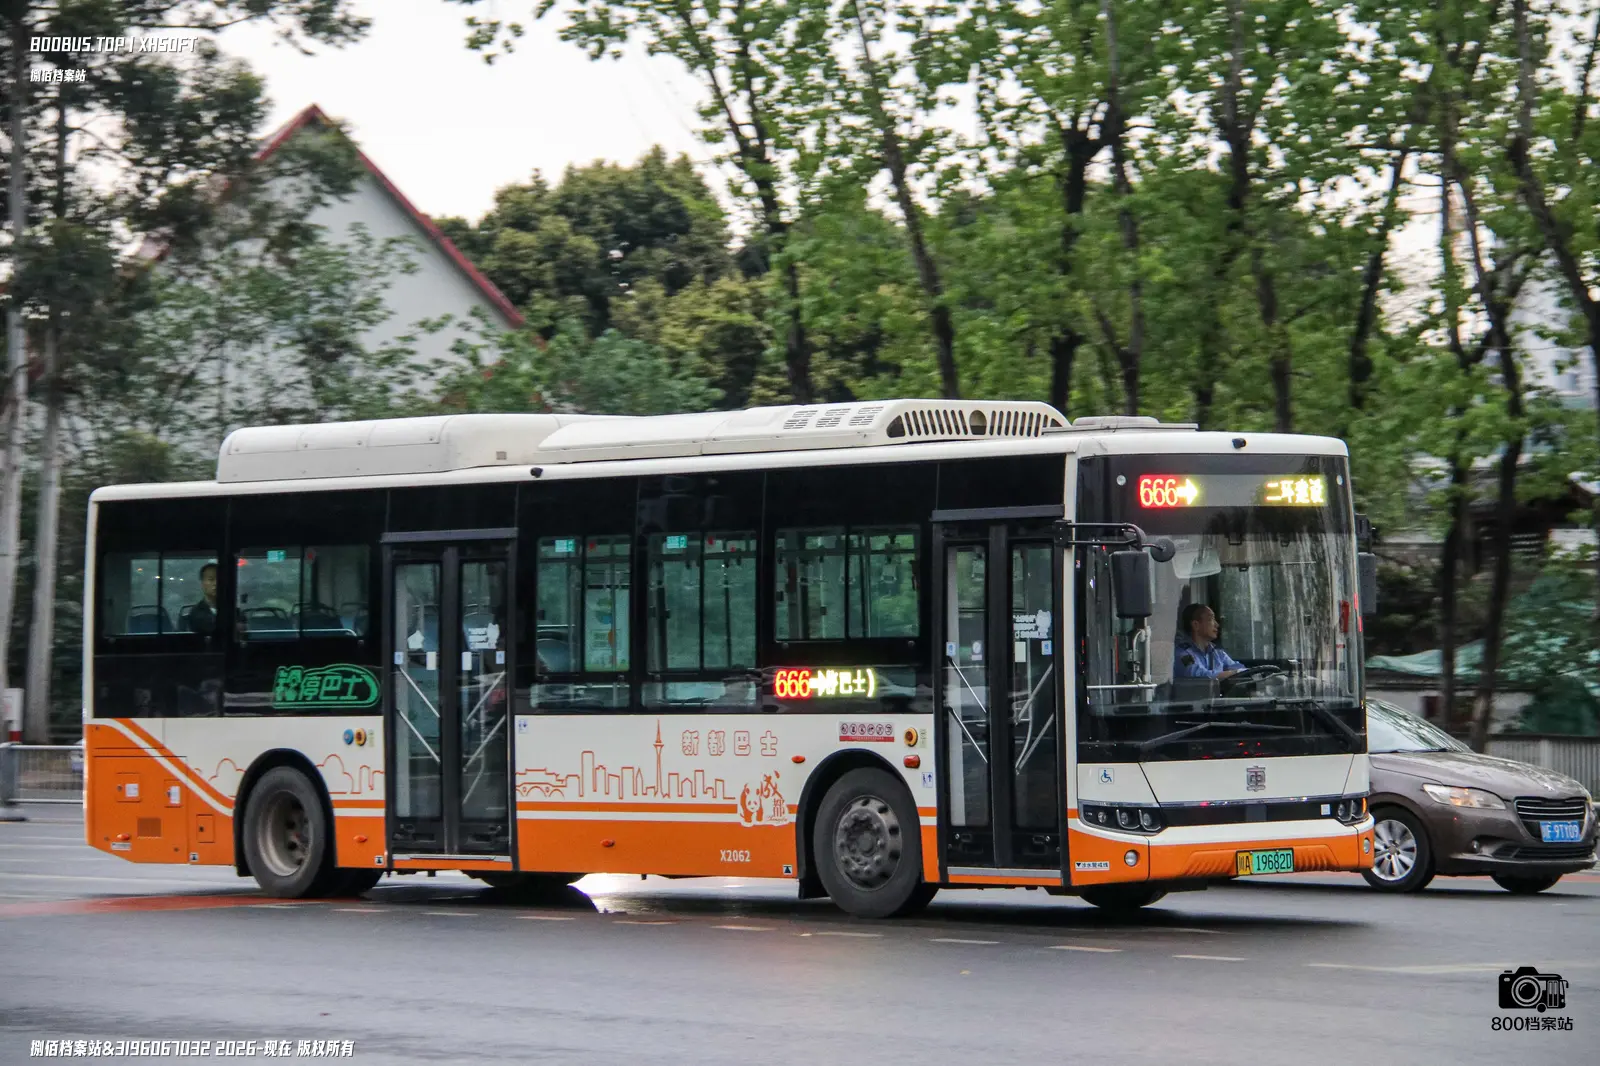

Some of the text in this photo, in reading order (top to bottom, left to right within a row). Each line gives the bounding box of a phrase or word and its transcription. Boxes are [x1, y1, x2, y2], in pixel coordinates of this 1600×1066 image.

[1139, 478, 1178, 506] 666
[776, 670, 811, 697] 666
[682, 729, 778, 757] 新都巴士
[720, 849, 751, 862] X2062
